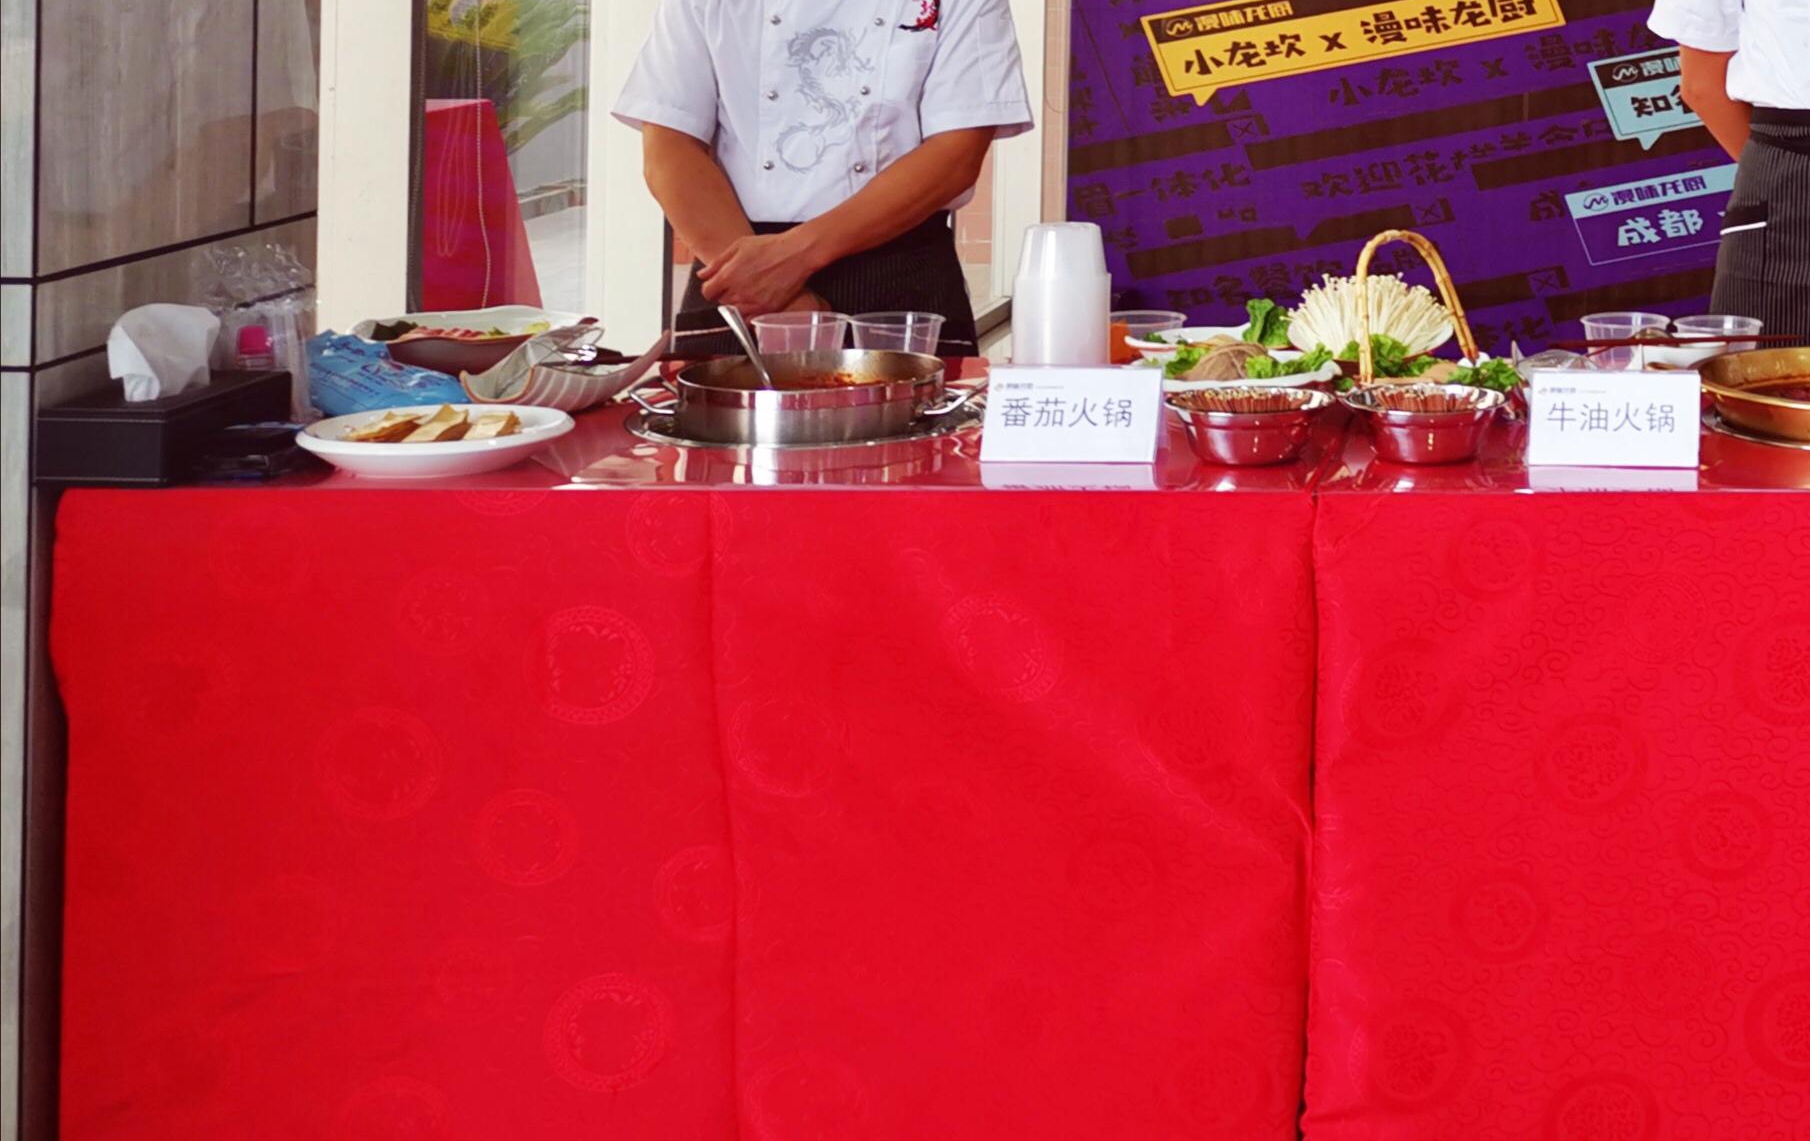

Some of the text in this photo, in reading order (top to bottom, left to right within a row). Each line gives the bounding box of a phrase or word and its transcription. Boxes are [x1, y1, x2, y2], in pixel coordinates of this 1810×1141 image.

[1184, 32, 1306, 76] 小龙坎
[1617, 208, 1704, 247] 成都
[1001, 396, 1133, 428] 番茄火锅
[1546, 400, 1676, 434] 牛油火锅
